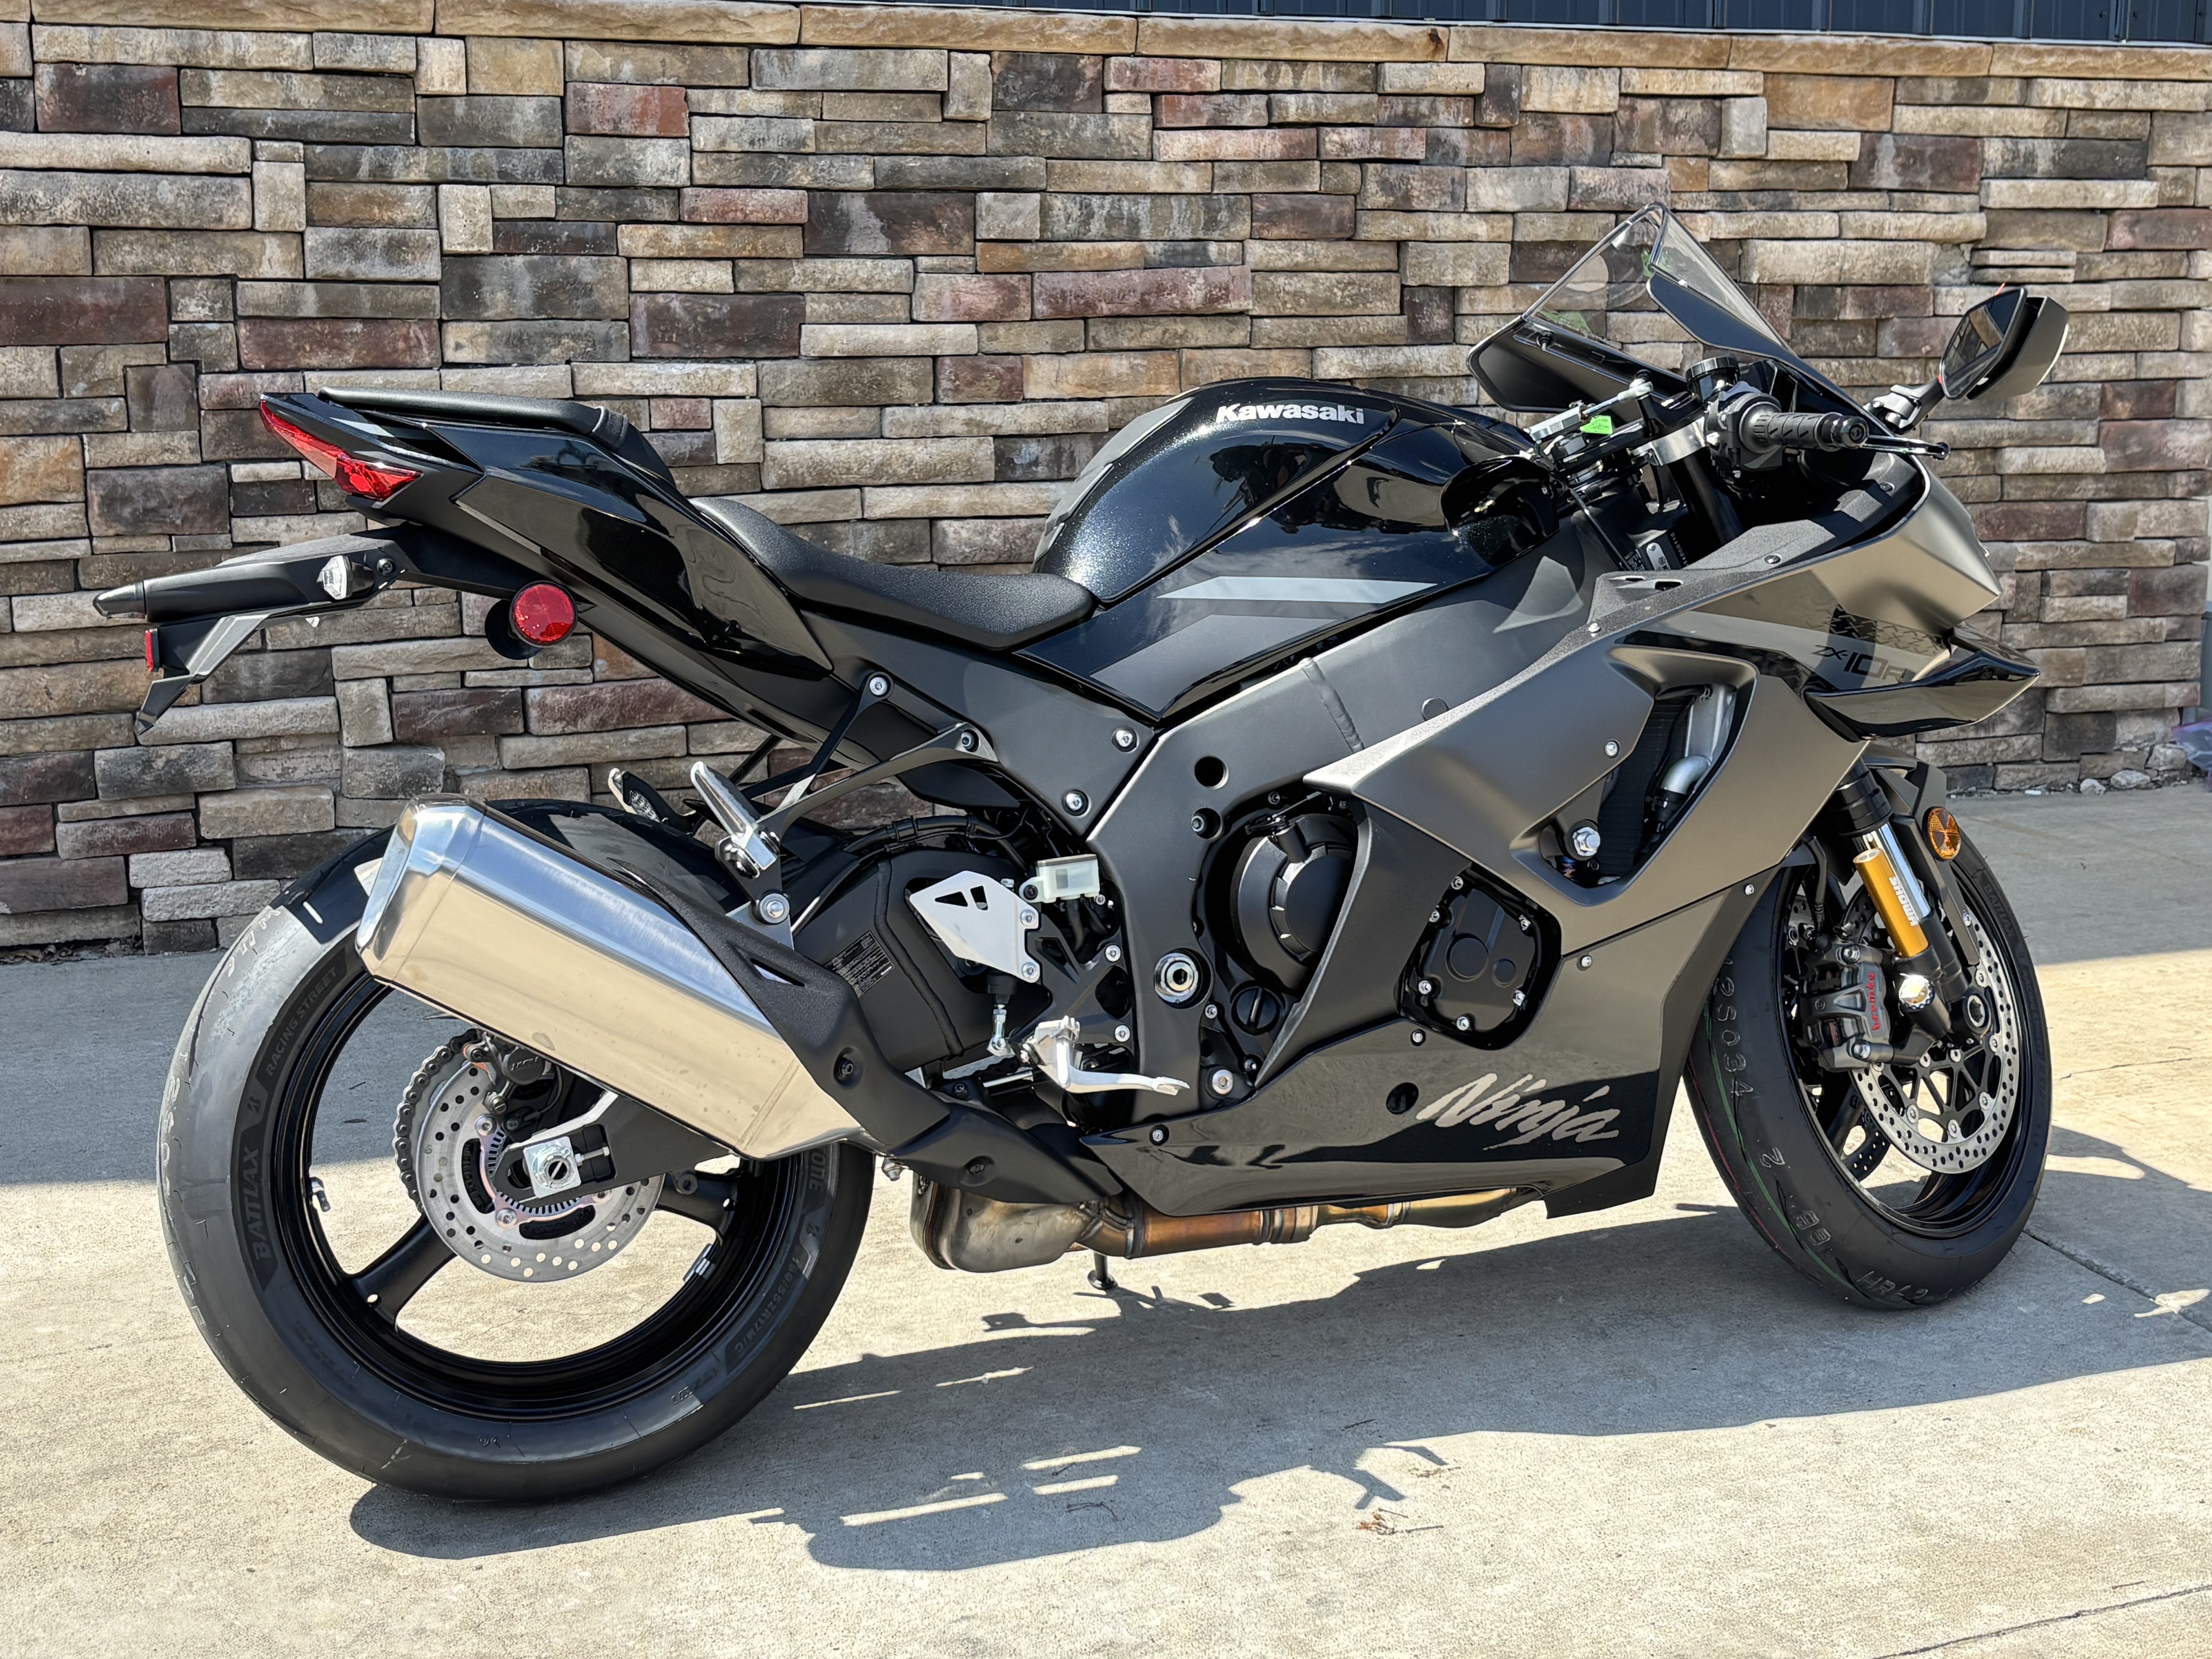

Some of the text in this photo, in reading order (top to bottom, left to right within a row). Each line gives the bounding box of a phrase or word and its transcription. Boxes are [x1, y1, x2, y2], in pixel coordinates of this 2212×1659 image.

[1216, 404, 1364, 424] Kawasaki
[1889, 876, 1919, 926] SHOWA
[266, 967, 337, 1075] RACING STREET
[1865, 972, 1881, 1031] brembo
[1416, 1073, 1620, 1151] Ninja
[242, 1146, 271, 1260] BATTLAX
